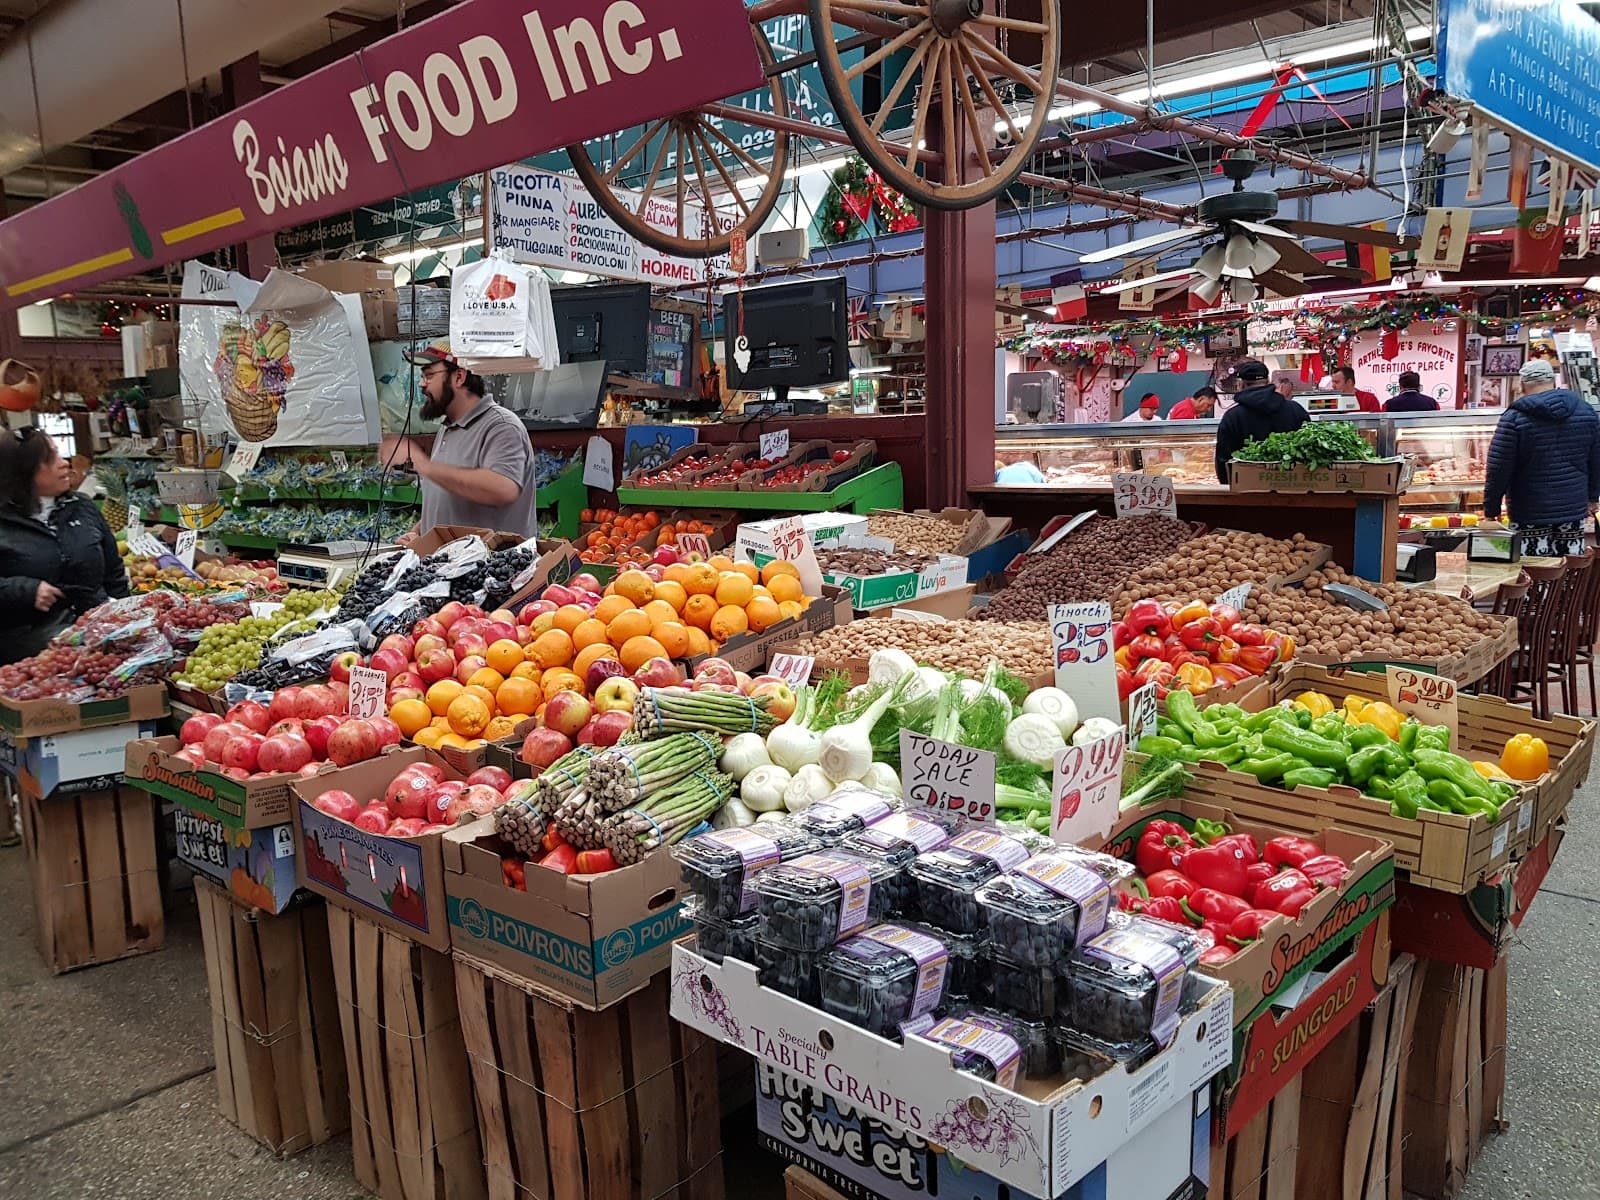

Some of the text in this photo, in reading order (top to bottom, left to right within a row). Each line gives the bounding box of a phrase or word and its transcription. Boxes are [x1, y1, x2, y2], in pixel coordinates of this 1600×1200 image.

[1526, 20, 1571, 71] AVENUE
[350, 35, 519, 164] FOOD
[522, 0, 683, 102] Inc.
[1548, 71, 1569, 98] BENE
[496, 171, 562, 192] RICOTTA
[414, 198, 441, 215] SERVED
[505, 192, 554, 213] PINNA
[510, 216, 561, 232] MANGIARE
[571, 223, 627, 243] PROVOLETTI
[570, 235, 630, 257] CACIOCAVALLO
[571, 250, 628, 271] PROVOLONI
[642, 258, 697, 283] HORMEL
[468, 301, 490, 310] LOVE
[660, 311, 684, 327] BEER
[1417, 341, 1455, 363] FAVORITE
[1418, 360, 1445, 371] PLACE
[1117, 474, 1160, 485] SALE
[1259, 471, 1330, 482] FRESH FIGS
[909, 735, 978, 767] TODAY
[143, 752, 216, 802] Sunsation
[913, 756, 972, 787] SALE
[174, 810, 224, 843] Harvest
[182, 834, 225, 866] Sweet
[320, 825, 395, 868] POMEGRANATES
[493, 915, 593, 976] POIVRONS
[1261, 892, 1370, 997] Sunsation
[1270, 975, 1358, 1074] SUNGOLD
[778, 1027, 828, 1060] Specialty
[750, 1025, 922, 1130] TABLE GRAPES
[782, 1100, 920, 1185] Sweet
[766, 1137, 861, 1196] CALIFORNIA TREE
